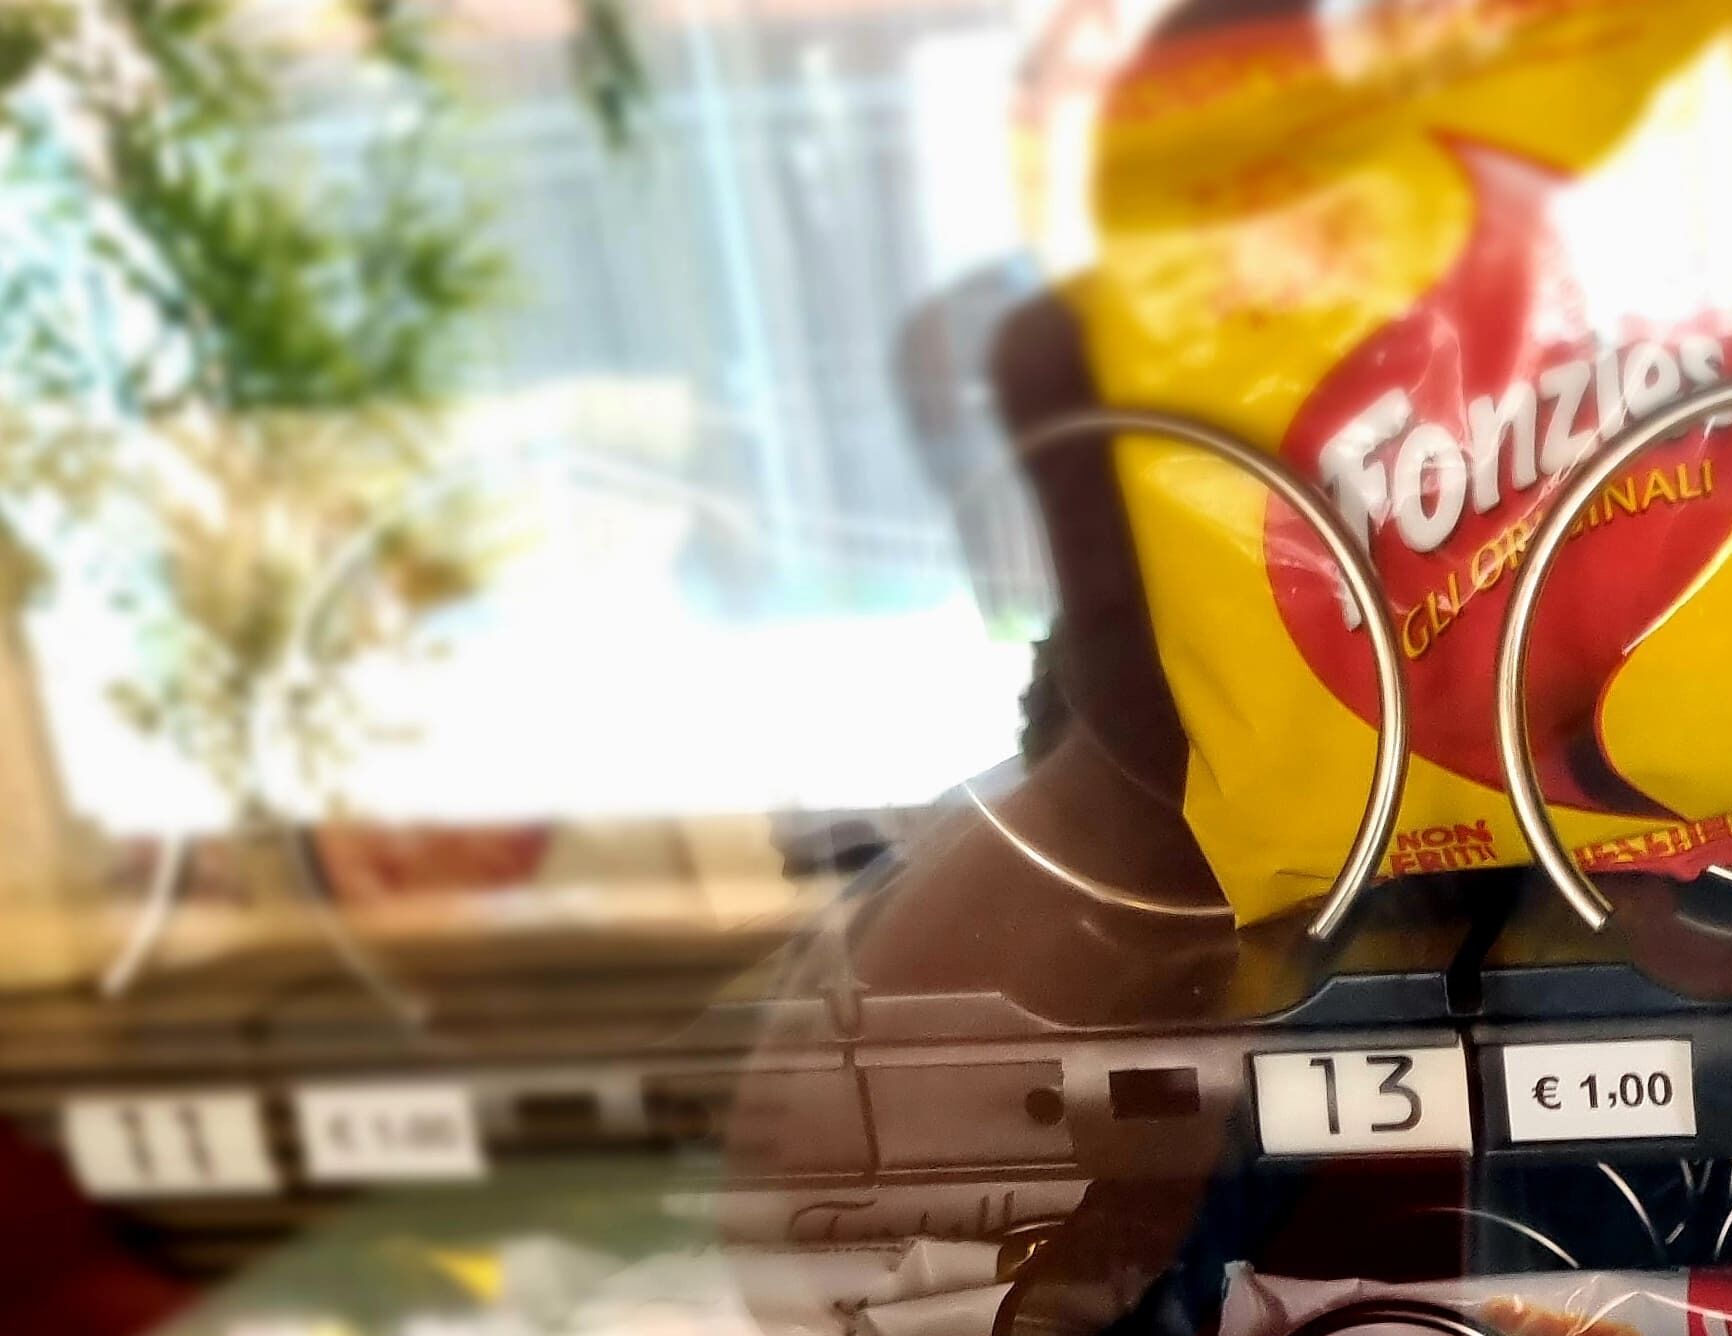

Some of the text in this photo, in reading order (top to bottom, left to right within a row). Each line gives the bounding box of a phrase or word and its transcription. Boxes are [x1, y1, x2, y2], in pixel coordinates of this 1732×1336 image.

[1402, 457, 1715, 661] GLI ORIINALI
[1396, 819, 1494, 852] NON
[1309, 1055, 1424, 1135] 13
[1531, 1072, 1674, 1111] € 1,00
